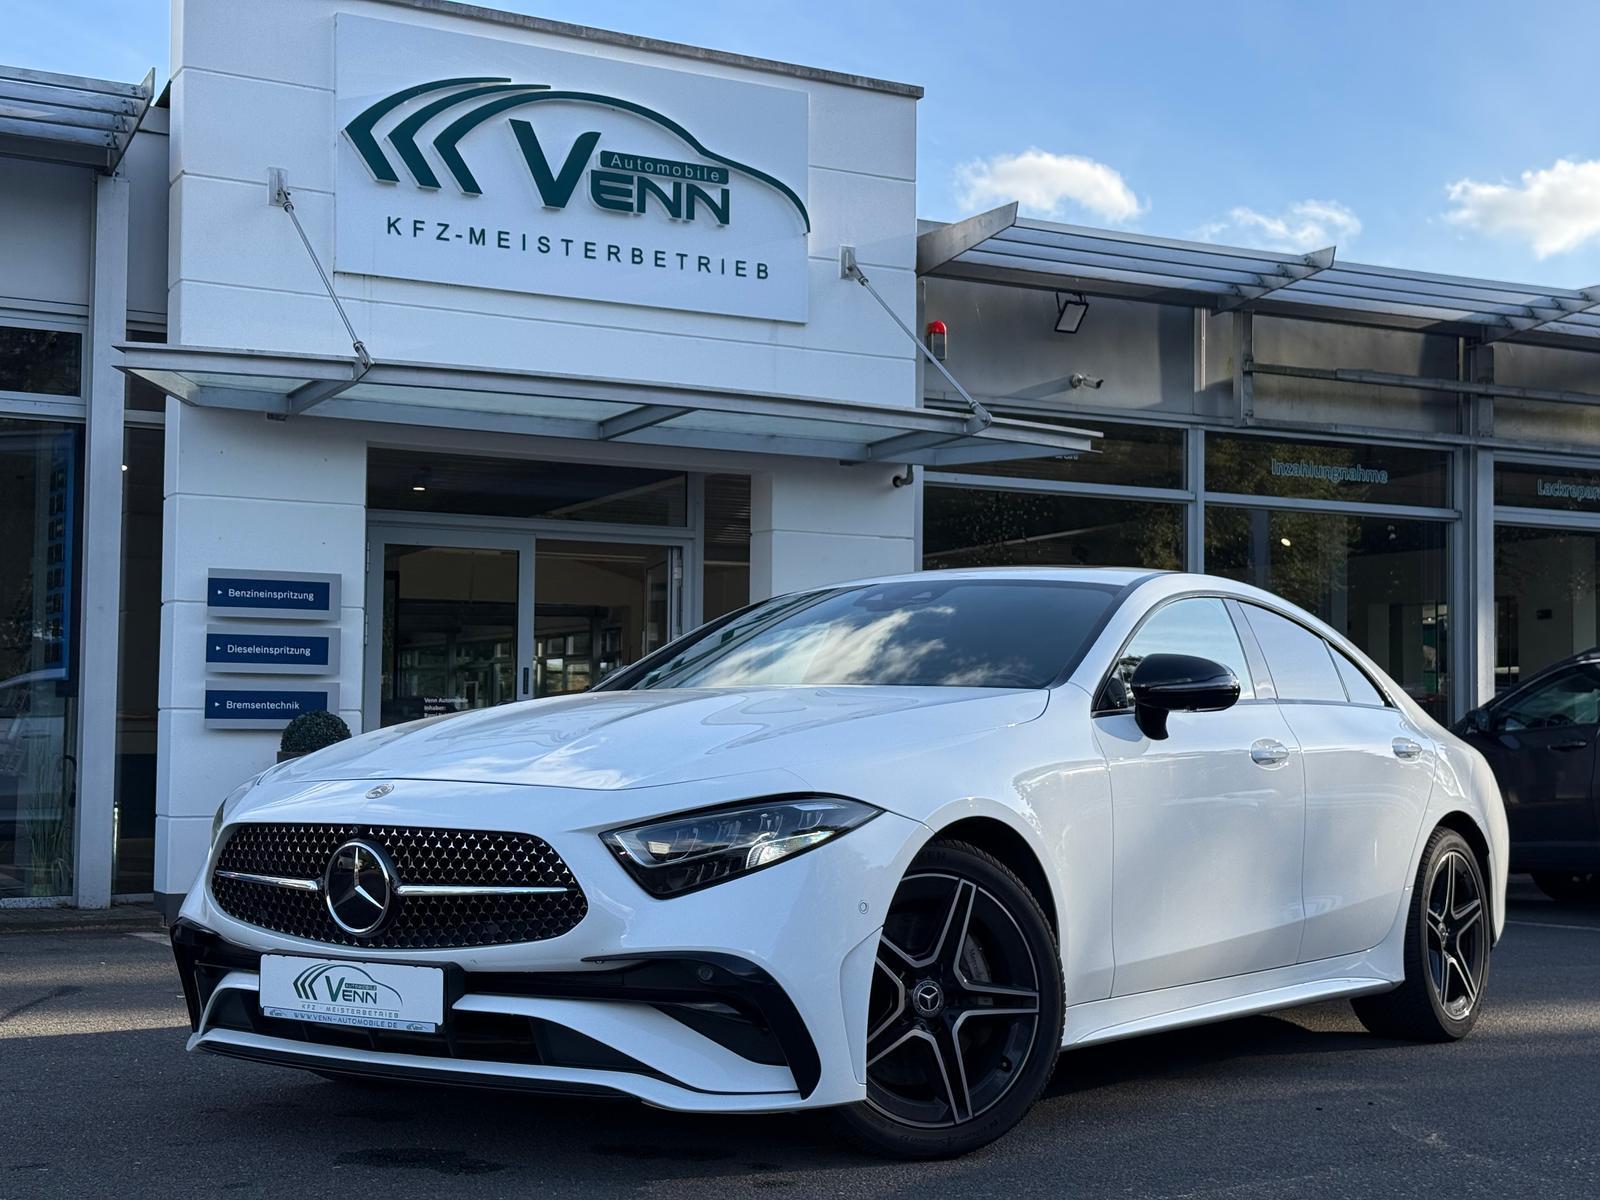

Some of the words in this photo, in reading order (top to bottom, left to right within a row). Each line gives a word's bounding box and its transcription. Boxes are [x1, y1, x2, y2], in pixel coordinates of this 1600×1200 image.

[509, 118, 730, 225] VENN
[610, 153, 720, 182] Automobile
[386, 216, 770, 280] KFZ-MEISTERBETRIEB
[1271, 458, 1388, 484] Inzahlungnahme
[1537, 478, 1600, 502] Lackrepar
[228, 587, 314, 602] Benzineinspritzung
[227, 644, 311, 657] Dieseleinspritzung
[226, 700, 300, 711] Bremsentechnik
[325, 975, 377, 1004] VENN
[326, 1006, 399, 1018] MEISTERBETRIEB
